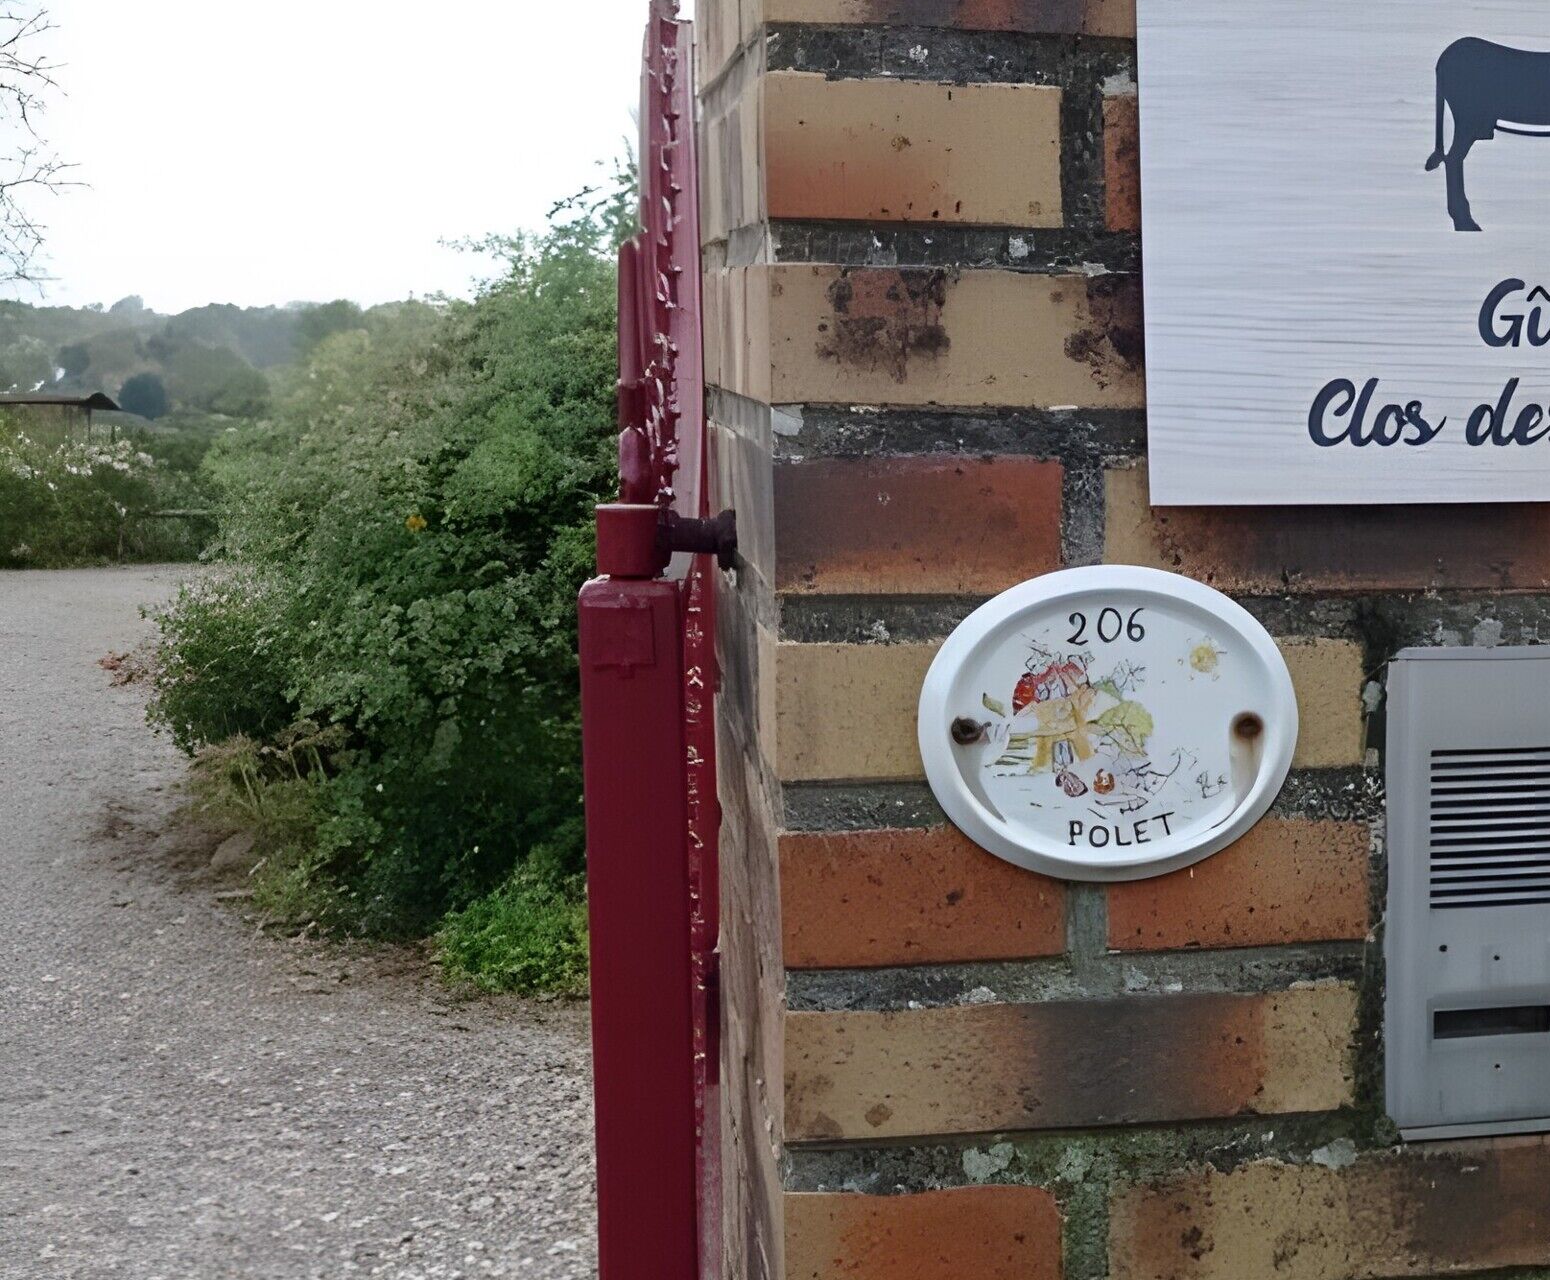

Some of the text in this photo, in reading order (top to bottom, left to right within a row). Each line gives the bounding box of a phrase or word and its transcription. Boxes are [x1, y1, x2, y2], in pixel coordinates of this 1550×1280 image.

[1307, 377, 1446, 447] Clos
[1066, 606, 1146, 646] 206
[1067, 811, 1175, 848] POLET
